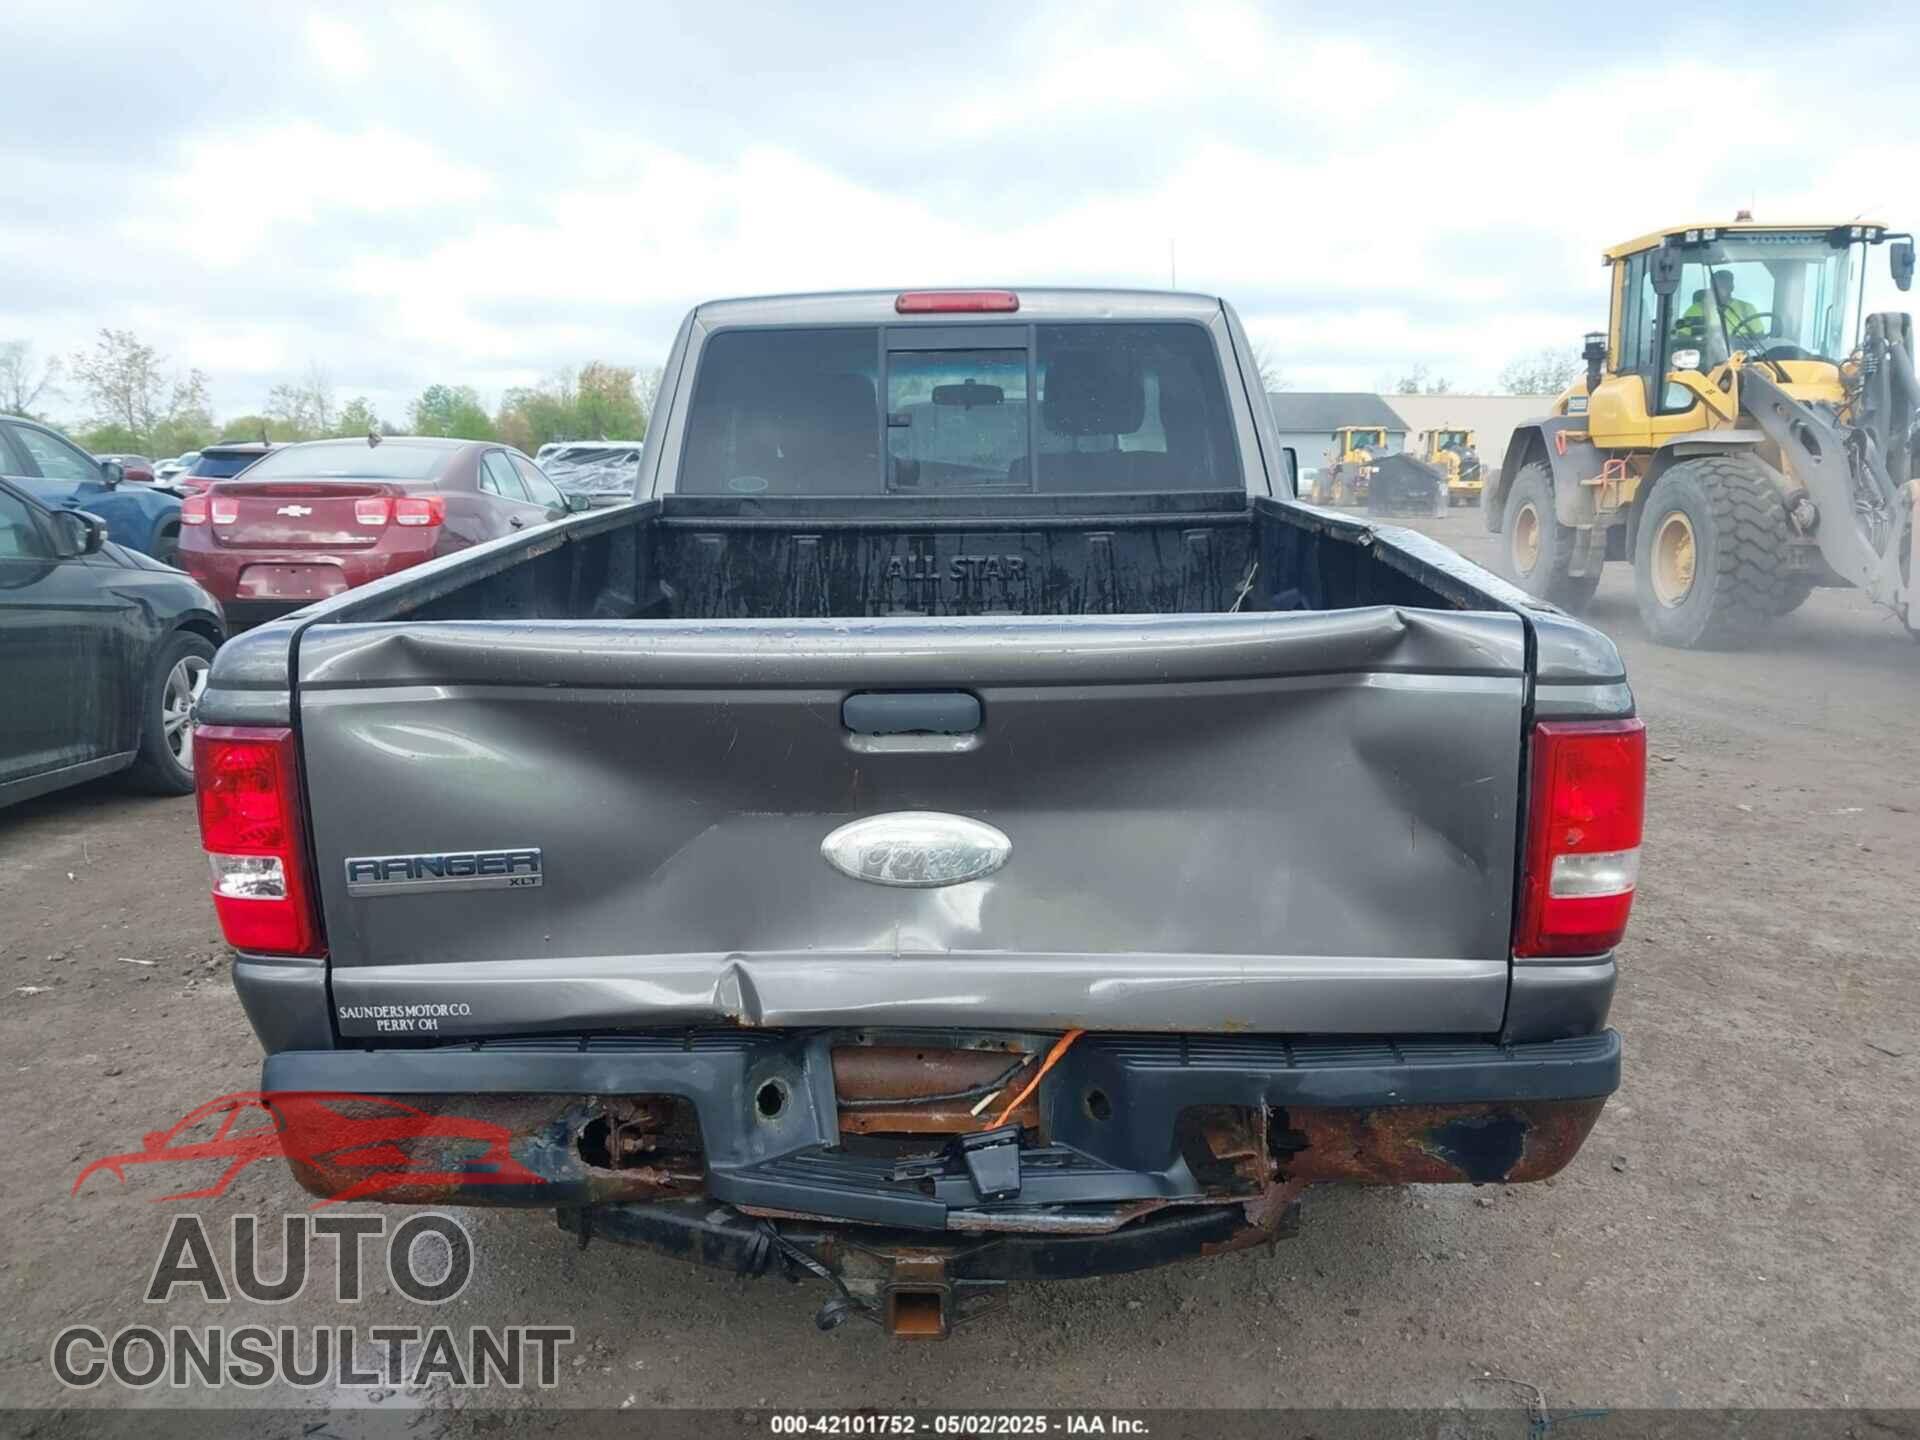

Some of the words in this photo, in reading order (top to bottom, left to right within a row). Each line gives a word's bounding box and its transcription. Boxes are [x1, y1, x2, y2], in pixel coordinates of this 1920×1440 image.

[886, 554, 942, 582] ALL
[949, 554, 1026, 582] STAR
[348, 850, 540, 882] RANGER
[509, 876, 539, 887] XLT
[339, 1006, 405, 1019] SAUNDERS
[405, 1004, 449, 1017] MOTOR
[376, 1018, 416, 1031] PERRY
[418, 1018, 438, 1031] OH
